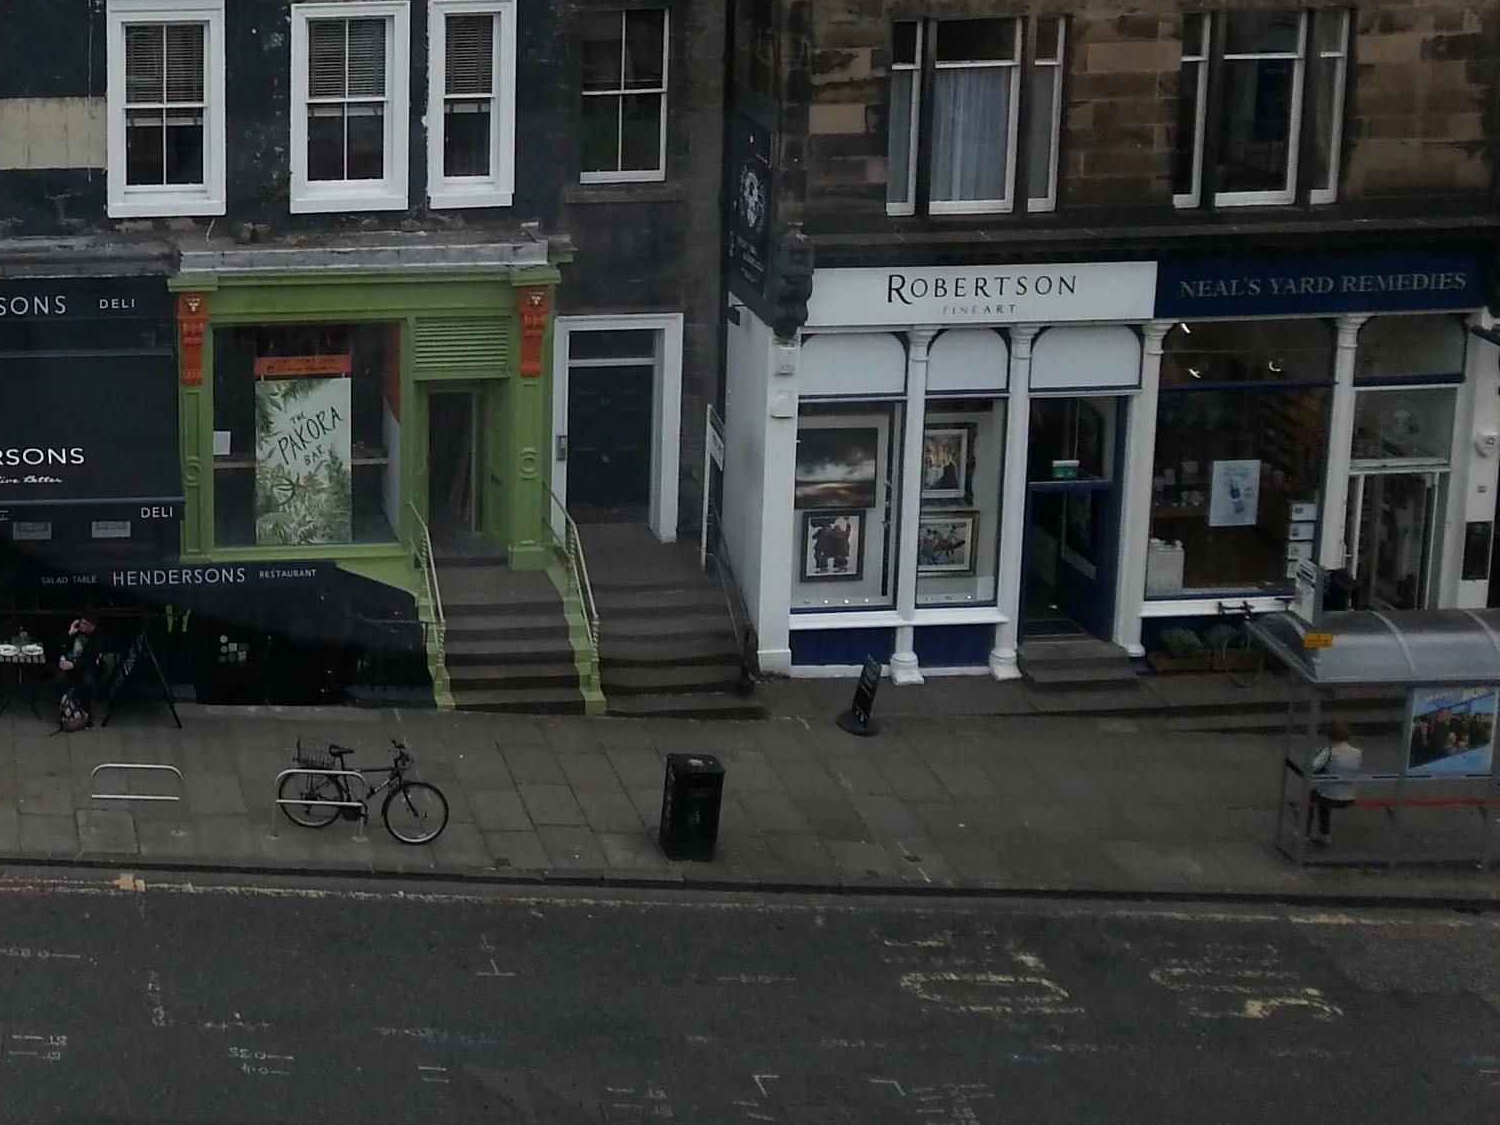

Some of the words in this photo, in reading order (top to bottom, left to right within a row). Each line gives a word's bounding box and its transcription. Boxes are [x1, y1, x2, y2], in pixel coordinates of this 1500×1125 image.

[887, 273, 1077, 305] ROBERTSON
[1179, 277, 1261, 299] NEAL'S
[1268, 275, 1334, 295] YARD
[1339, 272, 1468, 293] REMEDIES
[99, 298, 136, 309] DELI
[277, 405, 343, 466] PAKORA
[303, 444, 327, 466] BAR
[141, 507, 174, 518] DELI
[41, 576, 68, 585] SALAD
[72, 575, 97, 584] TABLE
[112, 567, 246, 586] HENDERSONS
[259, 569, 317, 579] RESTAURANT
